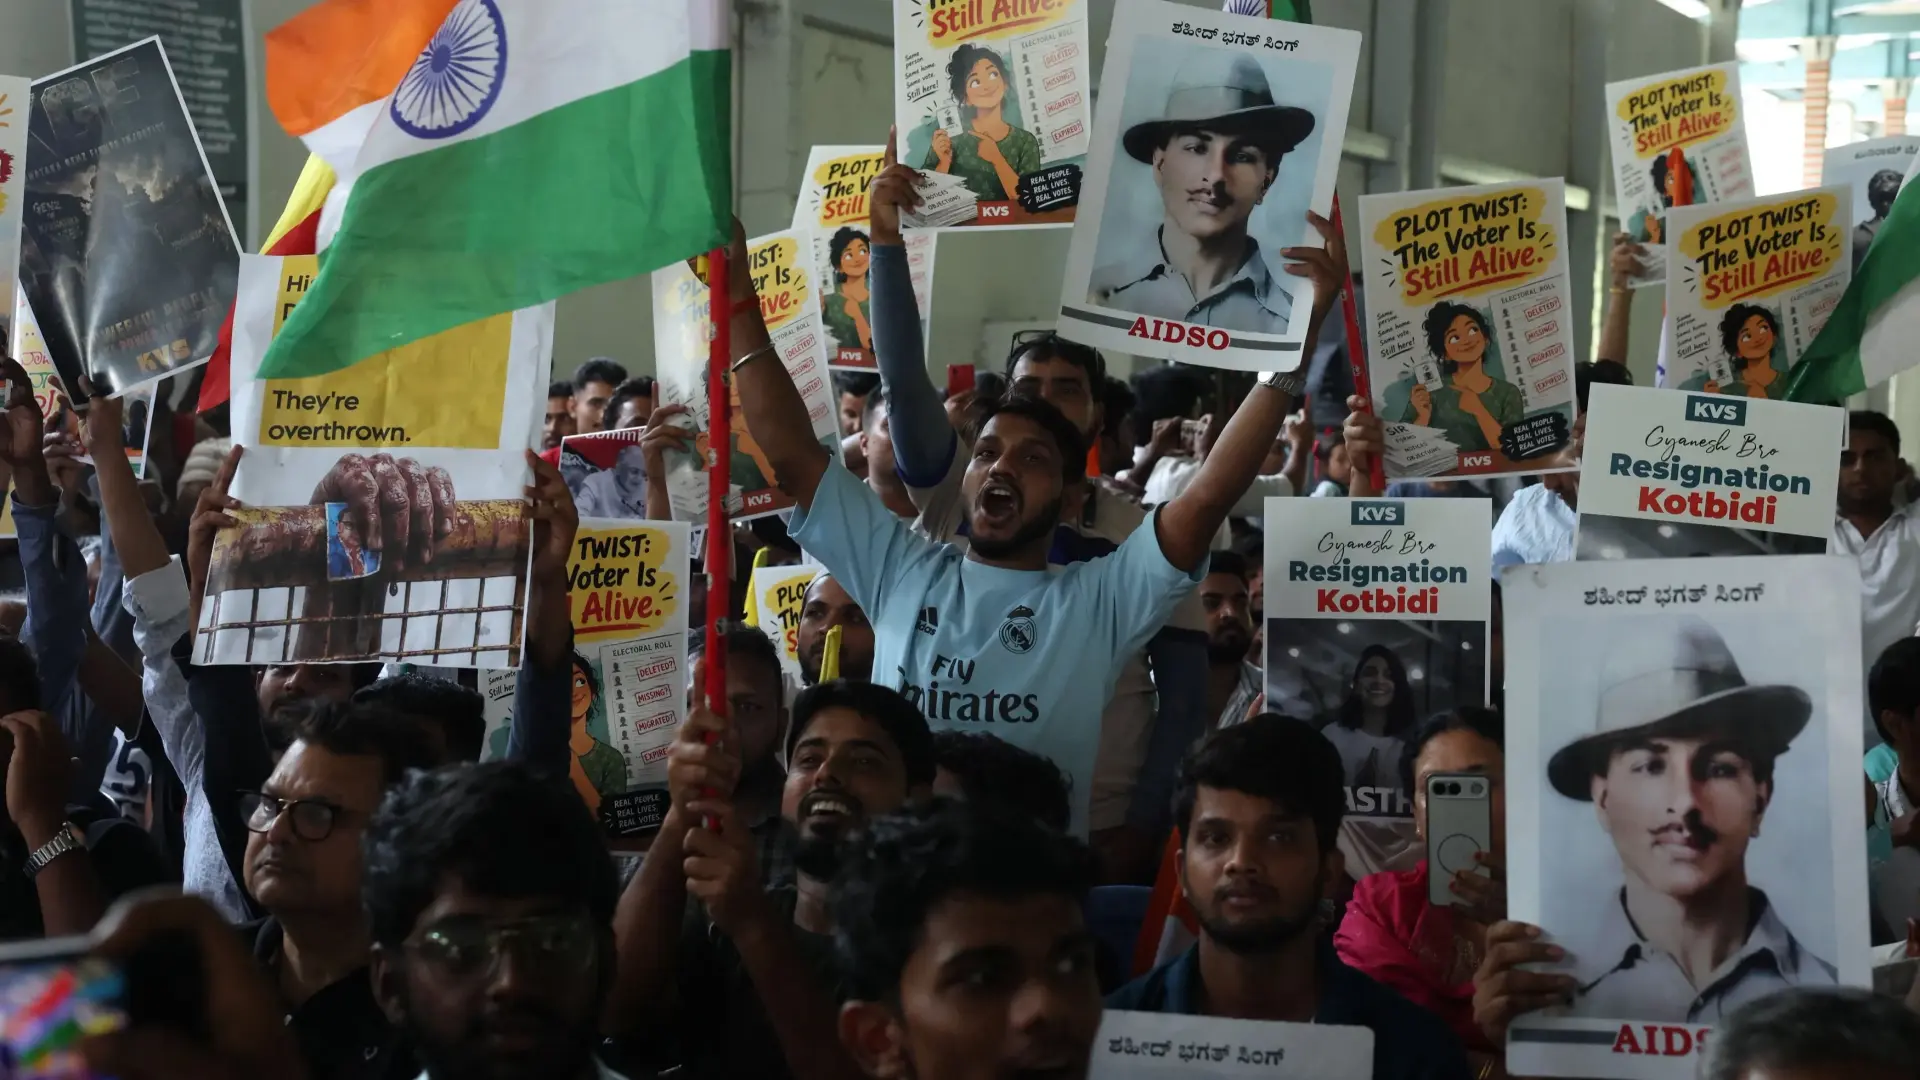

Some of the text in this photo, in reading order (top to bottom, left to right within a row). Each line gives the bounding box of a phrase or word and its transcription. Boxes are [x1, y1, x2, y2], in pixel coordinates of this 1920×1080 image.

[932, 4, 983, 38] Still
[1021, 34, 1056, 49] ELECTORAL
[1172, 20, 1300, 53] ಶಹೀದ್ ಭಗತ್ ಸಿಂಗ್
[907, 80, 938, 101] Still here!
[1628, 74, 1715, 114] PLOT TWIST:
[1047, 93, 1078, 113] MIGRATED?
[1628, 91, 1722, 133] The Voter Is
[1054, 123, 1080, 140] EXPIRED?
[1635, 124, 1672, 153] Still
[1677, 111, 1728, 137] Alive.
[828, 159, 871, 180] PLOT
[1030, 168, 1072, 186] REAL PEOPLE.
[823, 181, 855, 199] The
[926, 189, 948, 200] NOTICES
[1034, 178, 1070, 194] REAL LIVES.
[1036, 187, 1073, 204] REAL VOTES.
[823, 195, 864, 220] Still
[928, 195, 960, 210] OBJECTIONS
[982, 206, 1009, 217] KVS
[1394, 193, 1528, 242] PLOT TWIST:
[1698, 200, 1821, 250] PLOT TWIST:
[1393, 217, 1536, 270] The Voter Is
[1696, 222, 1825, 276] The Voter Is
[750, 243, 783, 270] IST:
[775, 266, 791, 286] Is
[1405, 246, 1544, 298] Still Alive.
[1705, 247, 1831, 301] Still Alive.
[286, 275, 315, 293] Hi
[1501, 283, 1555, 304] ELECTORAL ROLL
[760, 291, 799, 318] ive.
[1527, 300, 1558, 318] DELETED?
[796, 321, 810, 332] ROLL
[1128, 317, 1231, 351] AIDSO
[1528, 324, 1555, 340] MISSING?
[136, 337, 191, 371] KVS
[787, 336, 814, 357] DELETED?
[841, 351, 862, 361] KVS
[1380, 336, 1415, 357] Still here!
[1530, 345, 1562, 363] MIGRATED?
[789, 359, 814, 377] MISSING?
[1537, 372, 1564, 389] EXPIRED?
[272, 390, 359, 414] They're
[1694, 402, 1737, 421] KVS
[268, 421, 411, 443] overthrown.
[1386, 423, 1409, 436] SIR
[1514, 417, 1555, 434] REAL PEOPLE.
[1516, 427, 1554, 442] REAL LIVES.
[1404, 441, 1428, 452] NOTICES
[1519, 441, 1534, 451] REAL
[1644, 425, 1779, 461] Gyanesh Bro
[1406, 446, 1440, 461] OBJECTIONS
[1463, 455, 1492, 467] KVS
[1610, 452, 1811, 495] Resignation
[747, 493, 772, 507] KVS
[1637, 486, 1777, 525] Kotbidi
[1358, 507, 1397, 521] KVS
[578, 533, 651, 560] TWIST:
[1317, 529, 1436, 565] Gyanesh Bro
[566, 561, 657, 592] Voter Is
[1289, 558, 1468, 587] Resignation
[776, 580, 811, 607] PLO
[1317, 587, 1438, 615] Kotbidi
[1584, 582, 1765, 609] ಶಹೀದ್ ಭಗತ್ ಸಿಂಗ್
[581, 590, 662, 624] Alive.
[778, 606, 799, 630] Th
[612, 641, 672, 657] ELECTORAL ROLL
[640, 660, 673, 677] DELETED?
[930, 654, 975, 685] Fly
[489, 675, 502, 685] Same
[489, 684, 515, 698] Still her
[637, 687, 668, 703] MISSING?
[898, 665, 1039, 723] mirates
[638, 713, 673, 730] MIGRATED?
[644, 747, 669, 761] EXPIRE
[614, 799, 632, 808] REAL
[617, 808, 634, 818] REAL
[619, 818, 636, 828] REAL
[1108, 1037, 1286, 1067] ಶಹೀದ್ ಭಗತ್ ಸಿಂಗ್
